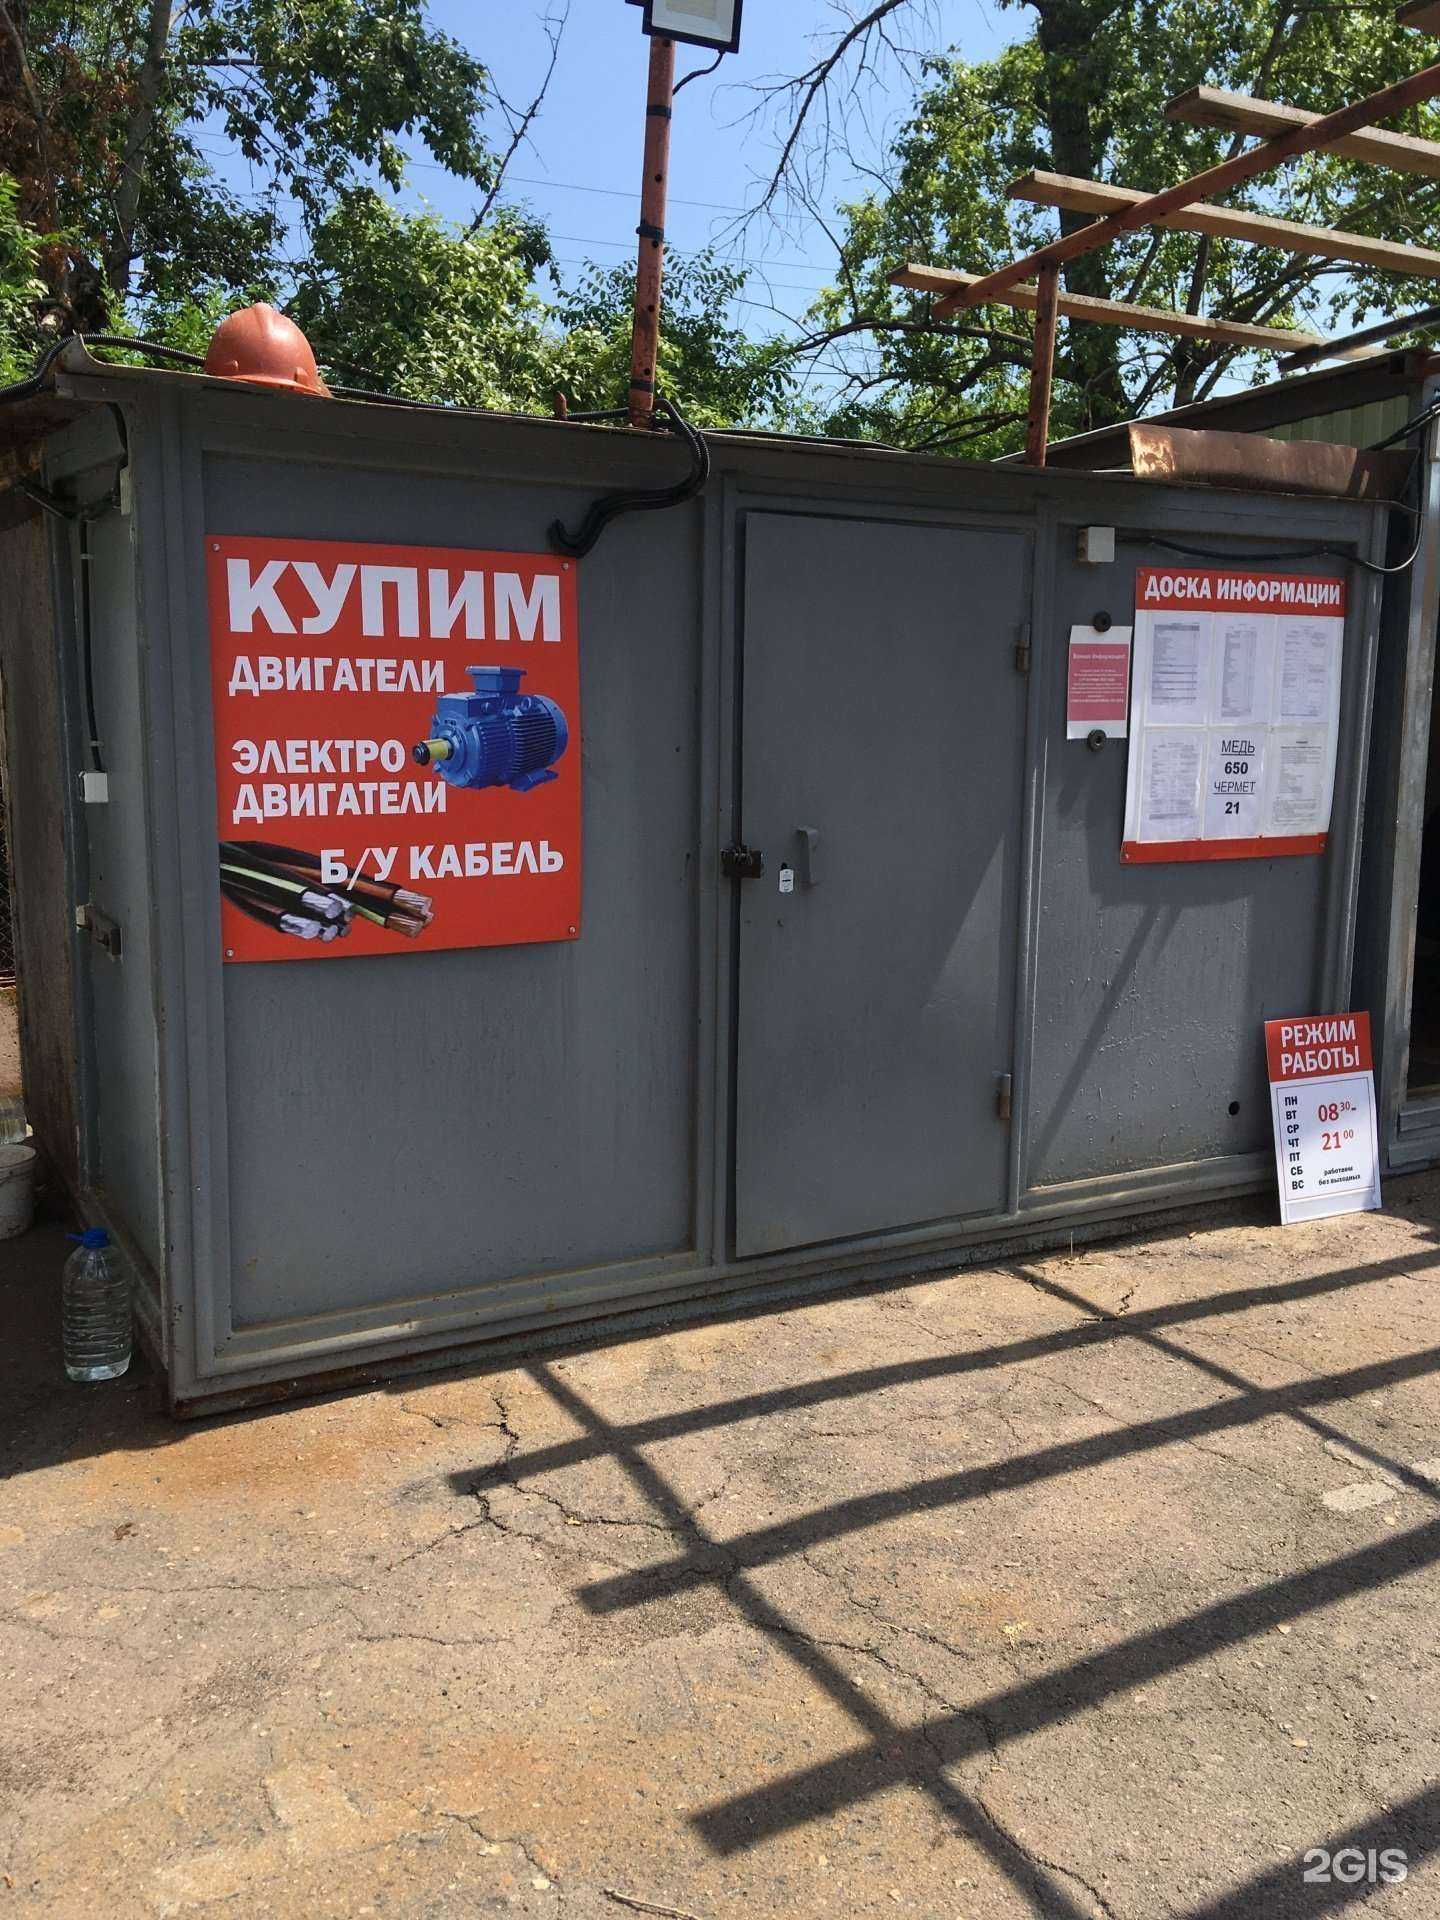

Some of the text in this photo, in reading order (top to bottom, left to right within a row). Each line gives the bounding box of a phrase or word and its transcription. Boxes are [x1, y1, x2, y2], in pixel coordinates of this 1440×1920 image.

[1144, 575, 1341, 607] ДОСКА ИНФОРМАЦИИ
[226, 558, 562, 642] КУПИМ
[228, 655, 446, 697] ДВИГАТЕЛИ
[1221, 739, 1256, 755] МЕДЬ
[231, 739, 406, 775] ЭЛЕКТРО
[1224, 761, 1249, 775] 650
[1213, 781, 1257, 793] ЧЕРМЕТ
[232, 781, 448, 825] ДВИГАТЕЛИ
[1224, 801, 1240, 815] 21
[319, 840, 565, 891] Б/У КАБЕЛЬ
[1280, 1019, 1357, 1048] РЕЖИМ
[1280, 1045, 1360, 1075] РАБОТЫ
[1284, 1095, 1298, 1107] ПН
[1285, 1109, 1298, 1120] ВТ
[1286, 1123, 1300, 1135] СР
[1288, 1137, 1300, 1148] ЧТ
[1289, 1151, 1301, 1162] ПТ
[1290, 1165, 1304, 1176] СБ
[1291, 1179, 1305, 1190] ВС
